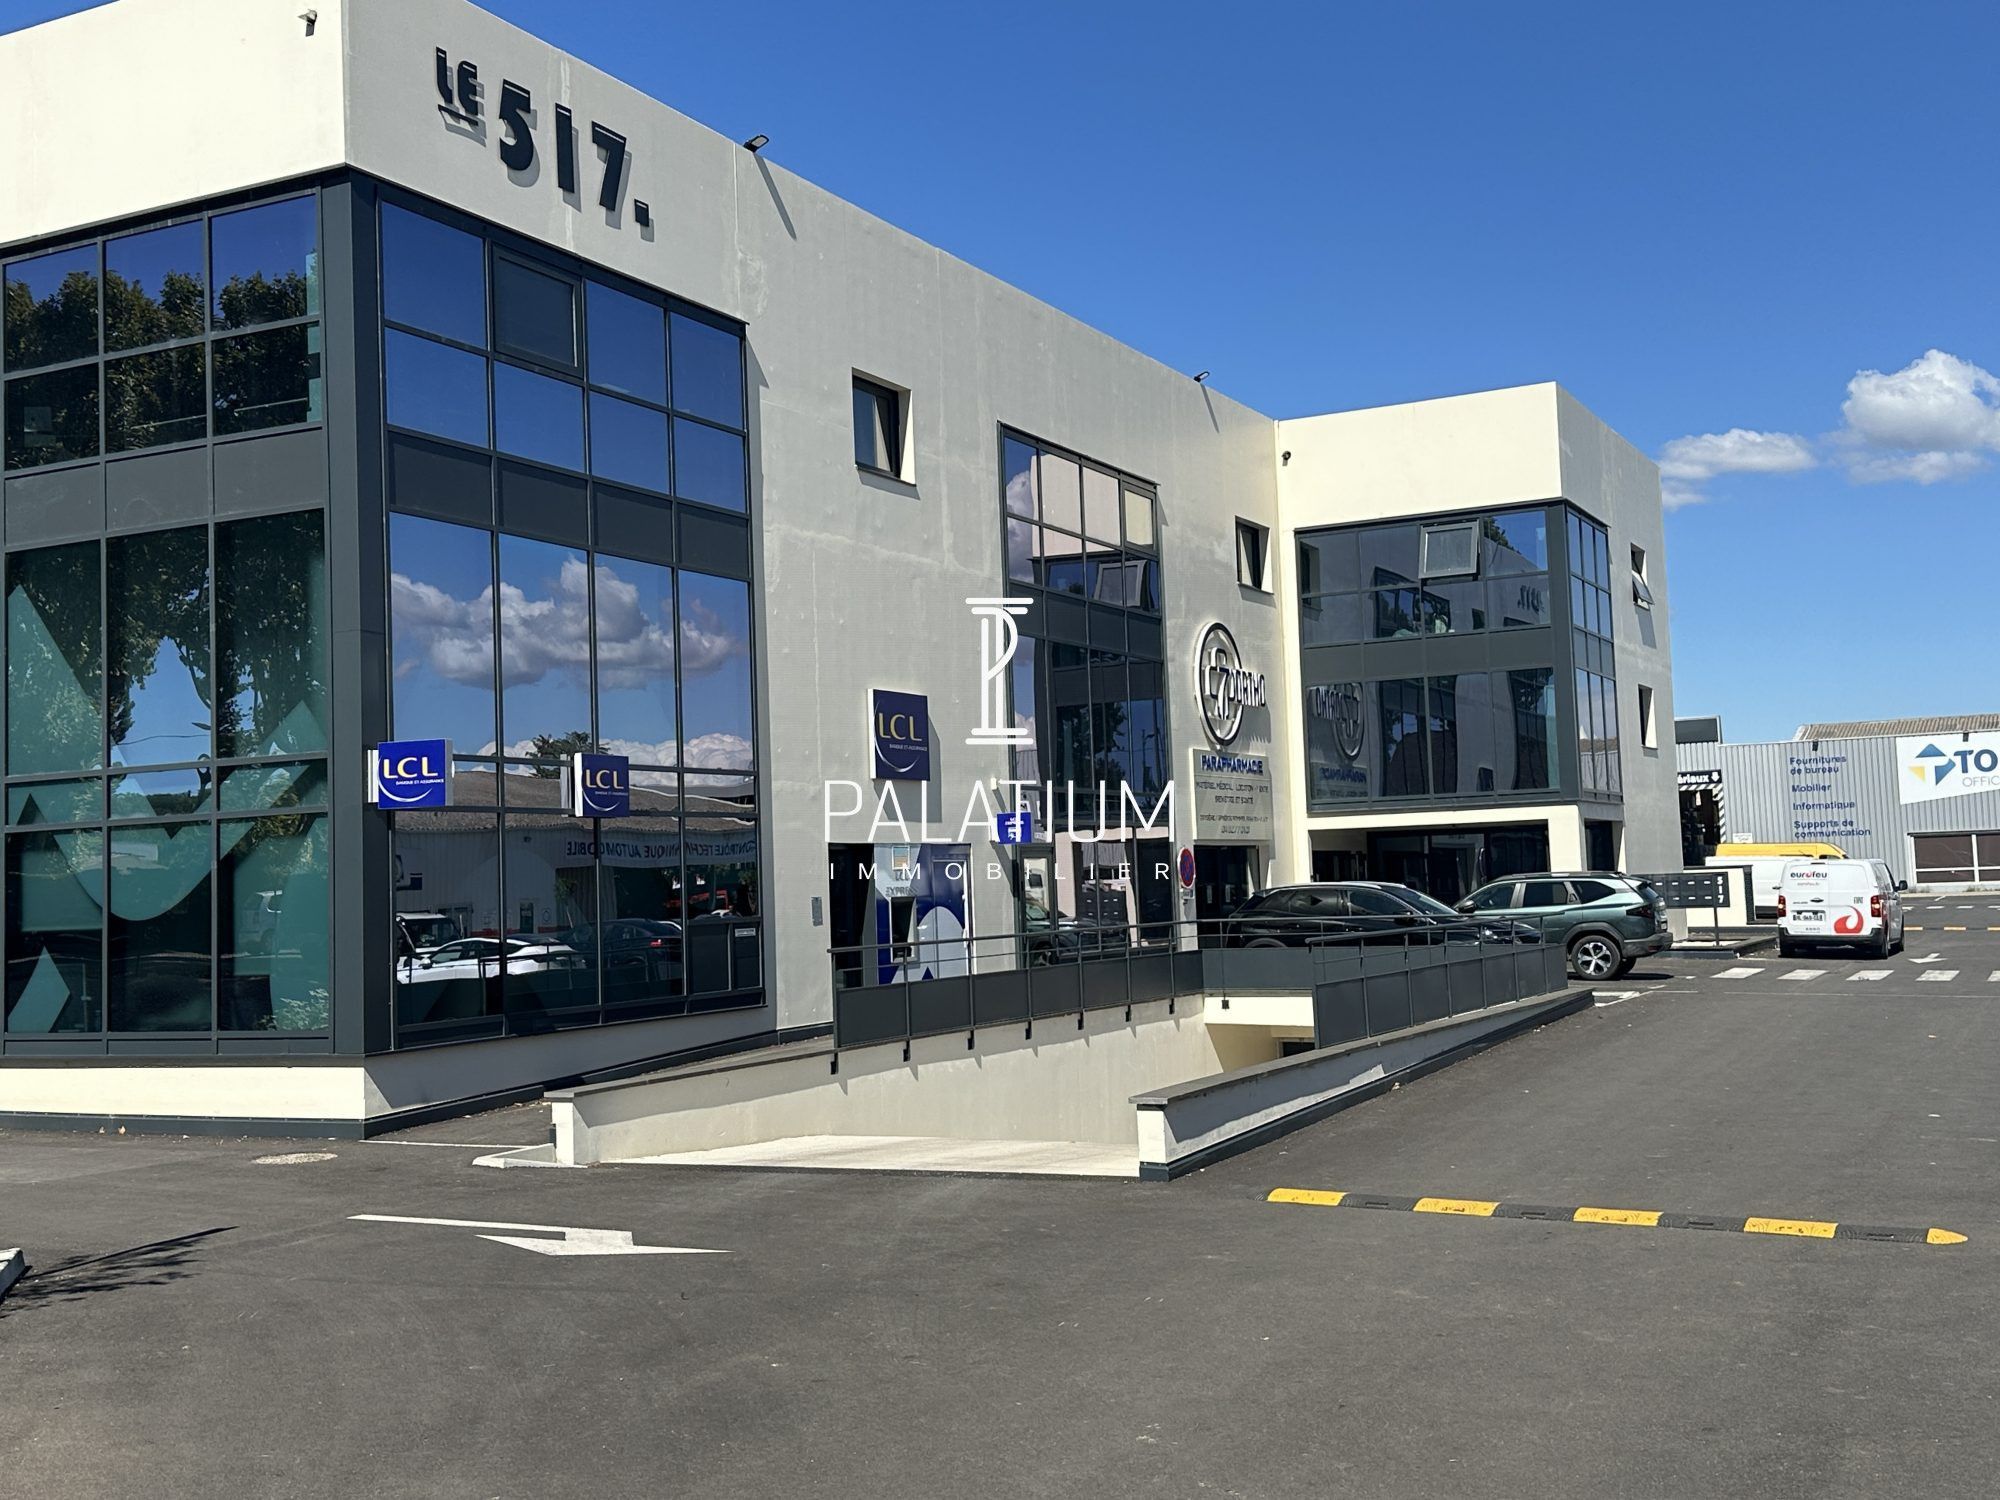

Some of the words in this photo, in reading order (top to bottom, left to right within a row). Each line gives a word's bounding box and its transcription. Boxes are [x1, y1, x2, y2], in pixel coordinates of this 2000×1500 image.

[435, 46, 478, 116] LE
[879, 713, 922, 741] LCL
[1790, 756, 1847, 765] Fournitures
[1953, 749, 1998, 774] TO
[383, 757, 439, 779] LCL
[1790, 767, 1802, 776] de
[1804, 766, 1839, 774] bureau
[586, 769, 624, 789] LCL
[1791, 784, 1832, 793] Mobilier
[1793, 801, 1855, 811] Informatique
[1794, 820, 1839, 830] Supports
[1841, 819, 1854, 828] de
[1794, 829, 1871, 840] communication
